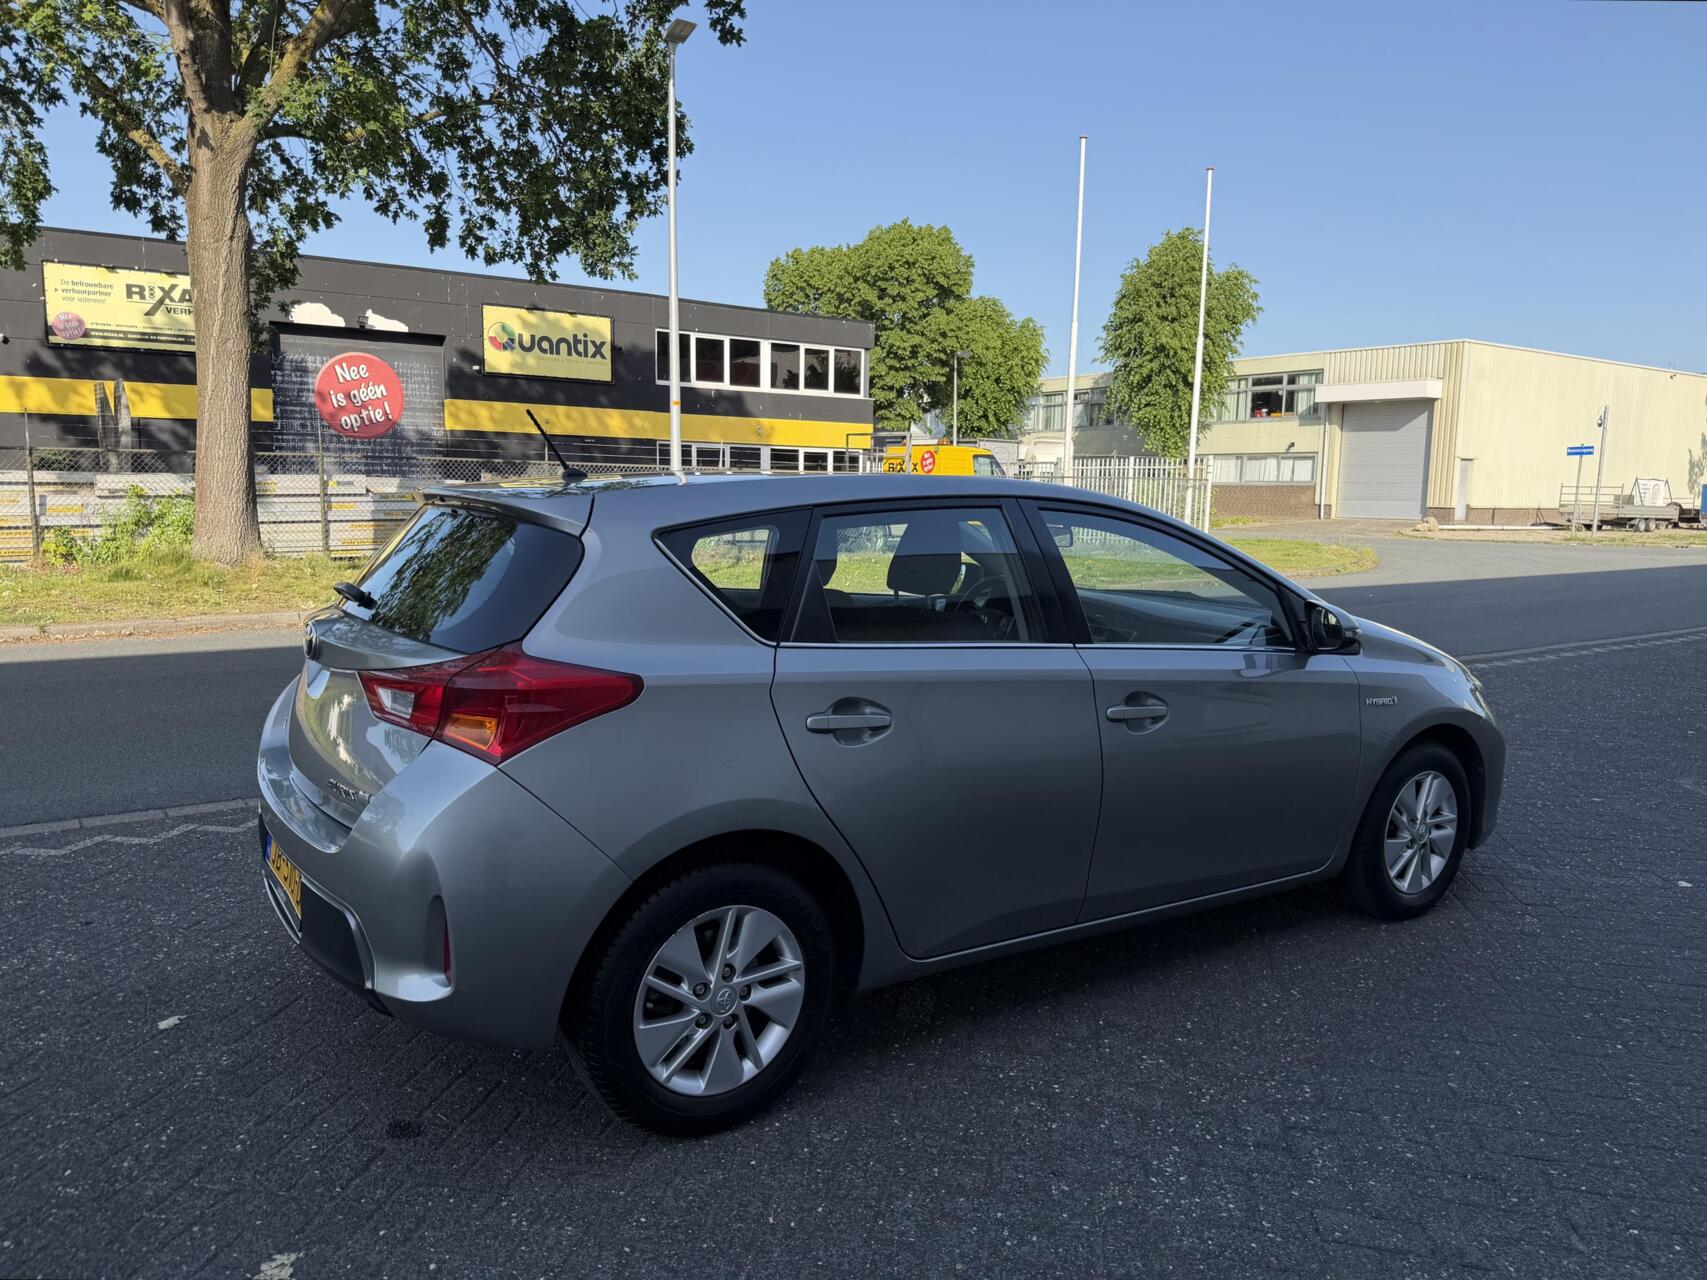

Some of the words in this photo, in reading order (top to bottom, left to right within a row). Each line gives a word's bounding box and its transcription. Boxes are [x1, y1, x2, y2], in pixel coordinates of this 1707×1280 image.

[61, 288, 111, 297] verhuurpartner
[72, 280, 114, 289] betrouwbare
[487, 321, 608, 360] Quantix
[334, 362, 369, 383] Nee
[329, 389, 347, 408] is
[350, 381, 388, 407] géén
[340, 401, 393, 432] optie!
[1366, 697, 1394, 705] HYBRID
